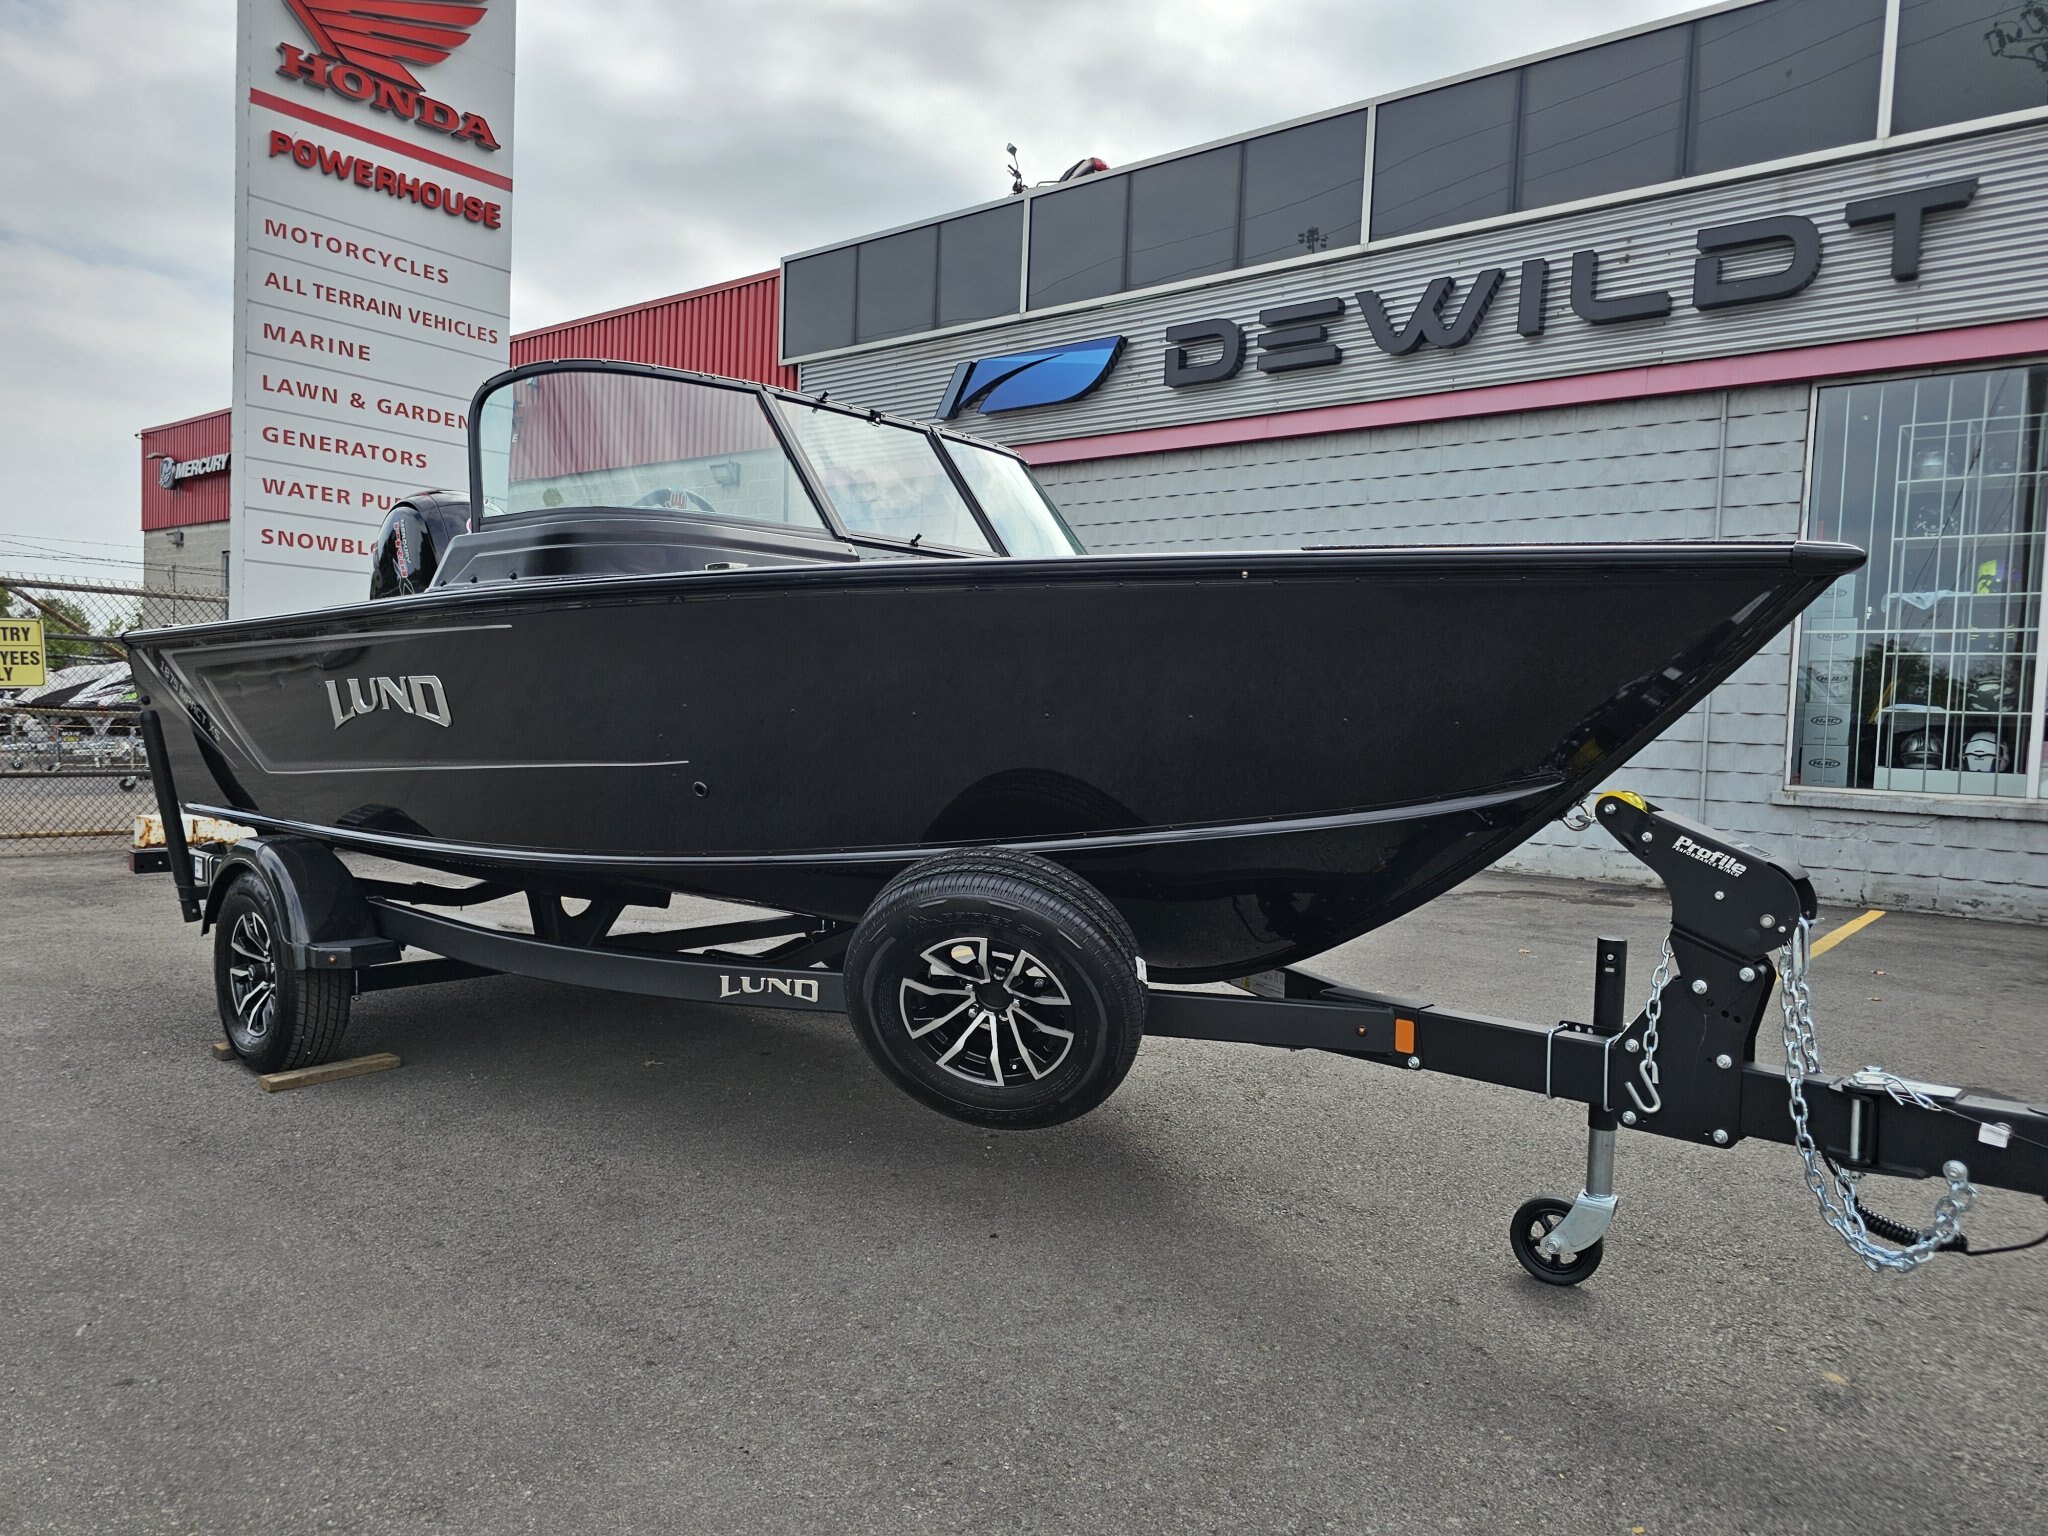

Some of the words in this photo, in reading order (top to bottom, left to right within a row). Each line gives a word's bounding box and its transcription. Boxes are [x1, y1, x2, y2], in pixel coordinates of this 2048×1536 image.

[276, 42, 501, 151] HONDA
[269, 130, 501, 229] POWERHOUSE
[265, 218, 449, 284] MOTORCYCLES
[264, 272, 307, 296] ALL
[312, 283, 401, 320] TERRAIN
[408, 307, 498, 344] VEHICLES
[1163, 177, 1980, 390] DEWILDT
[263, 323, 371, 361] MARINE
[262, 374, 338, 404] LAWN
[350, 392, 365, 410] &
[376, 398, 468, 430] GARDEN
[175, 452, 230, 479] MERCURY
[262, 426, 428, 469] GENERATORS
[262, 477, 350, 505] WATER
[361, 492, 402, 510] PU
[160, 660, 179, 691] 1875
[179, 684, 207, 724] IMPACT
[208, 721, 220, 742] XS
[325, 675, 451, 730] LUND
[1672, 845, 1716, 868] PERFORMANCE
[1718, 864, 1740, 877] WINCH
[1674, 835, 1747, 874] Profile
[720, 975, 819, 1003] LUND
